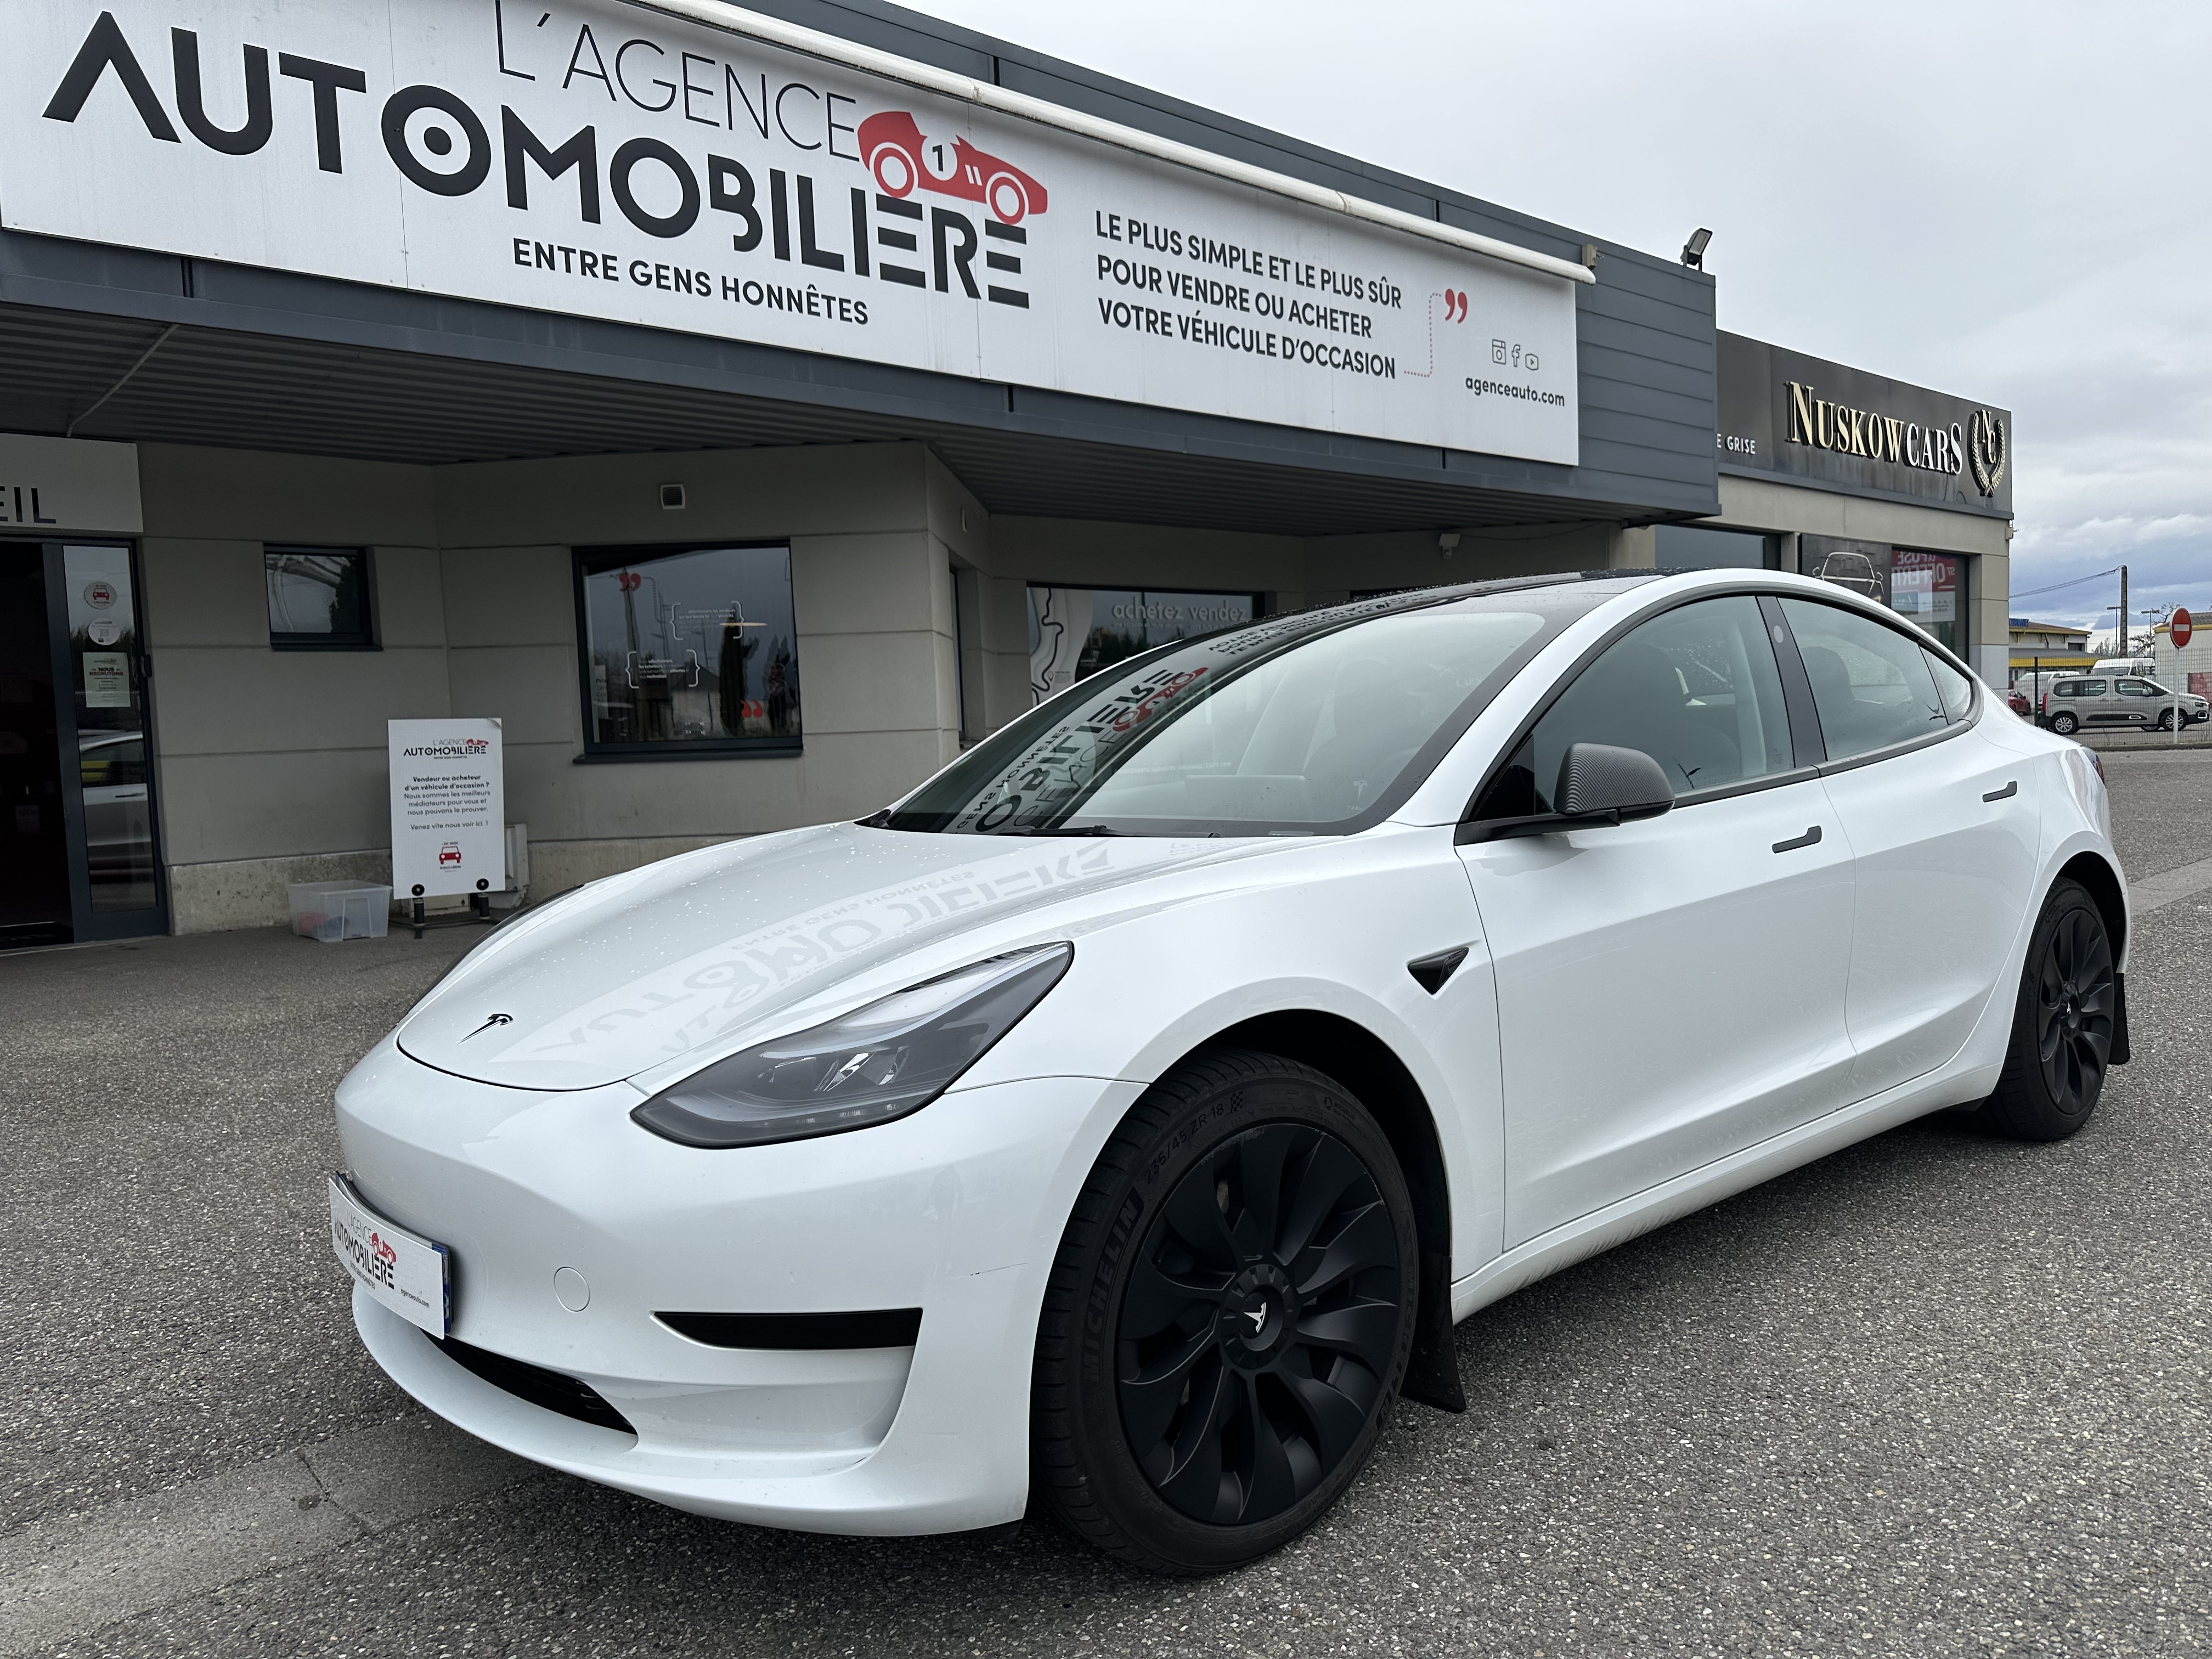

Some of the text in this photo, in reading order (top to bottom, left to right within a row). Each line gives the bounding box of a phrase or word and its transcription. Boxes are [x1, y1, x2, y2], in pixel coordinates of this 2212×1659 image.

[496, 0, 860, 162] L'AGENCE
[512, 238, 868, 325] ENTRE GENS HONNÊTES
[1095, 210, 1402, 309] LE PLUS SIMPLE ET LE PLUS SÛR
[1097, 254, 1372, 339] POUR VENDRE OU ACHETER
[1098, 298, 1396, 380] VOTRE VÉHICULE D'OCCASION
[1465, 375, 1565, 408] agenceauto.com
[1726, 436, 1756, 454] GRISE
[1112, 596, 1247, 621] achetez vendez
[1144, 1130, 1188, 1184] 235/45
[1191, 1114, 1208, 1135] ZR
[1211, 1103, 1224, 1119] 18
[347, 1209, 373, 1246] L'AGENCE
[1084, 1198, 1138, 1383] MICHELIN
